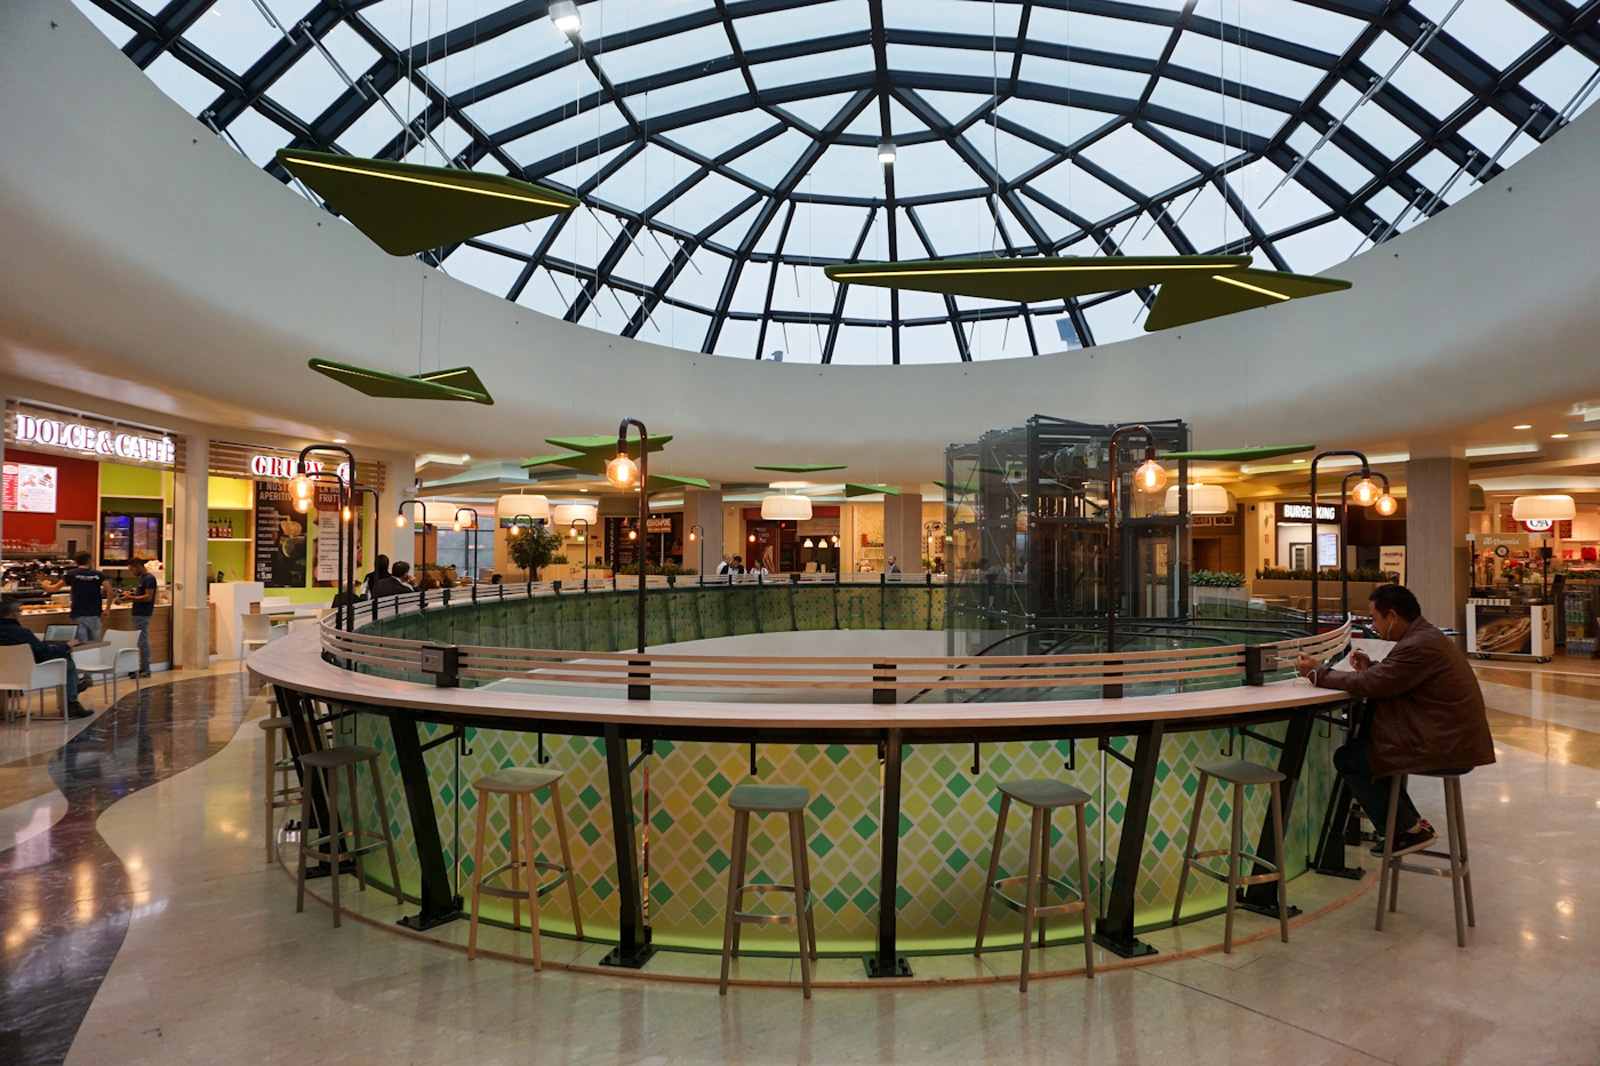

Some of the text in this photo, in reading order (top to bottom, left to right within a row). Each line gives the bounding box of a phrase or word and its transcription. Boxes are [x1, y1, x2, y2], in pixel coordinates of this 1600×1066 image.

[16, 414, 95, 450] DOLCE
[259, 491, 293, 501] APERITIV
[1284, 504, 1335, 520] BURGE KING
